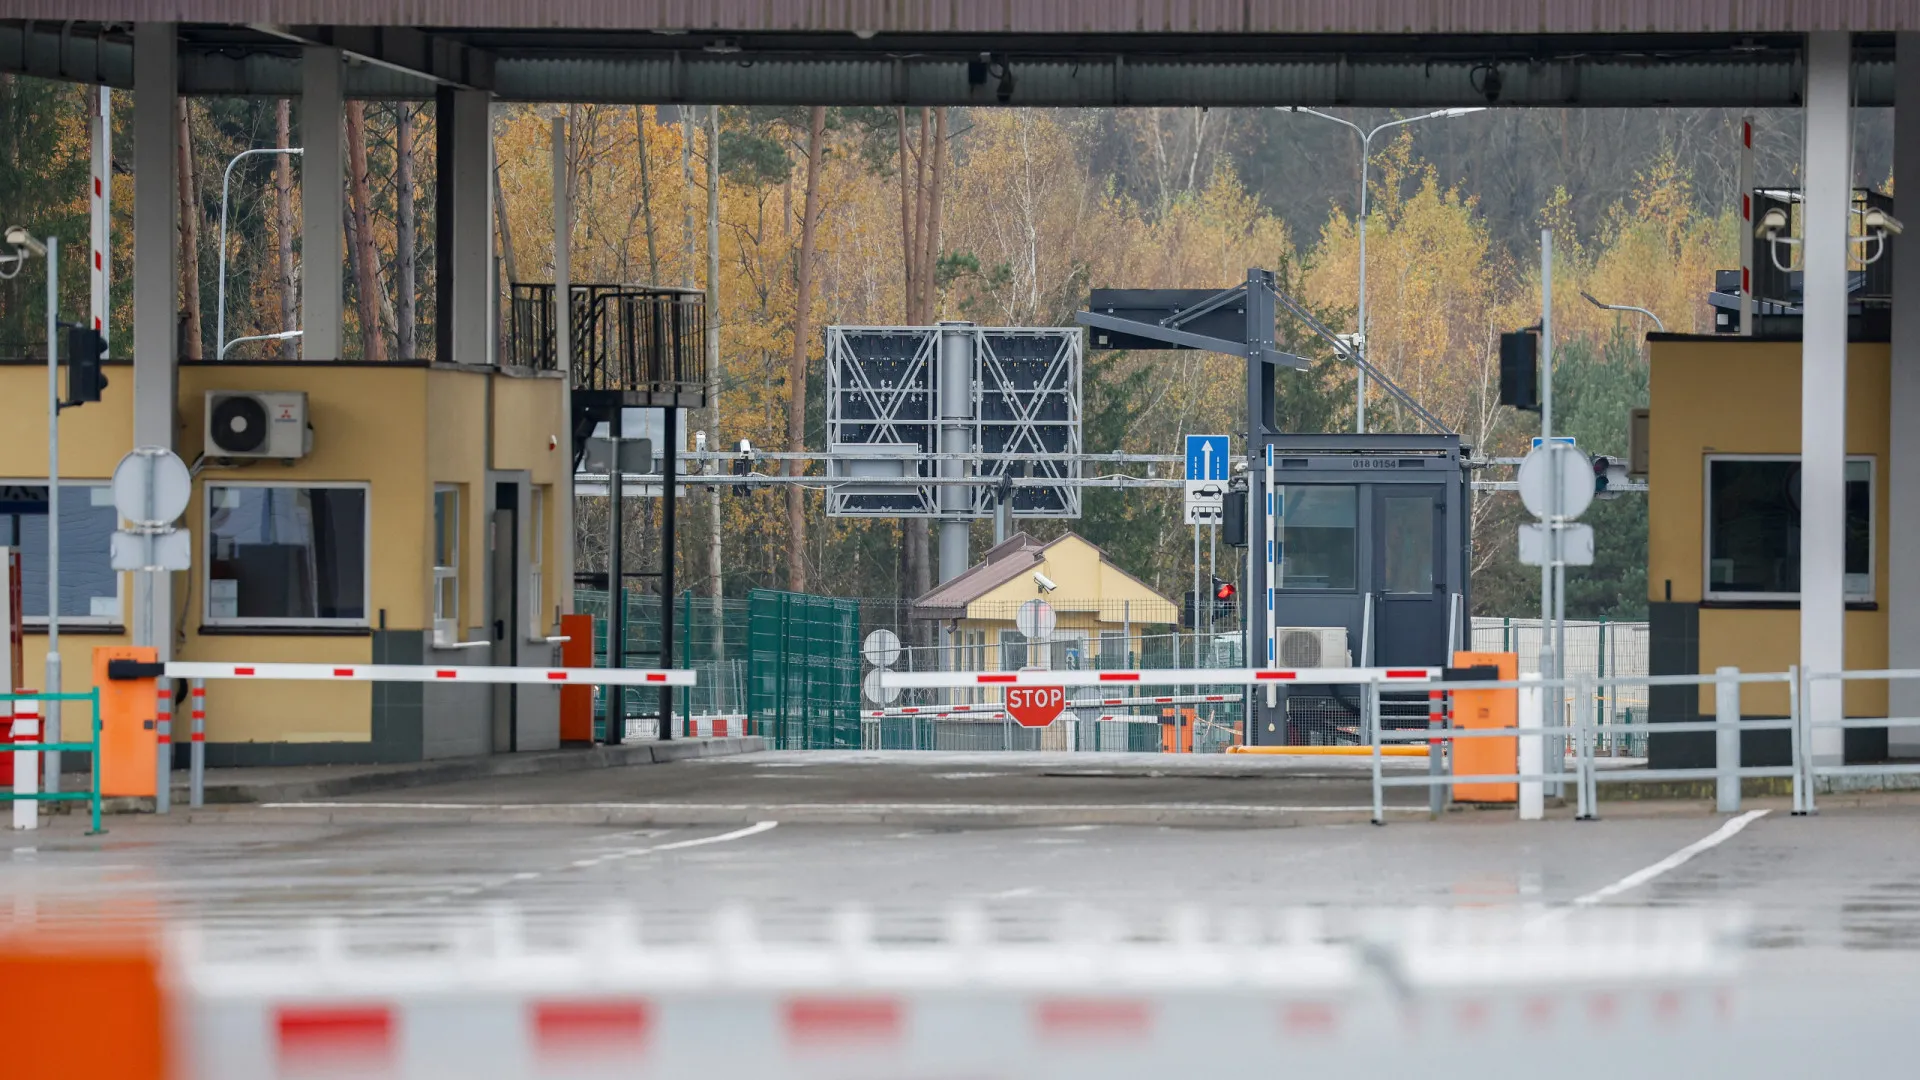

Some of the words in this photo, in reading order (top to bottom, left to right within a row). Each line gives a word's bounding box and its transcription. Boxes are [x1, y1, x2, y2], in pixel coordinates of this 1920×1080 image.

[1353, 459, 1370, 468] 018
[1373, 459, 1396, 468] 0154
[1009, 689, 1062, 708] STOP
